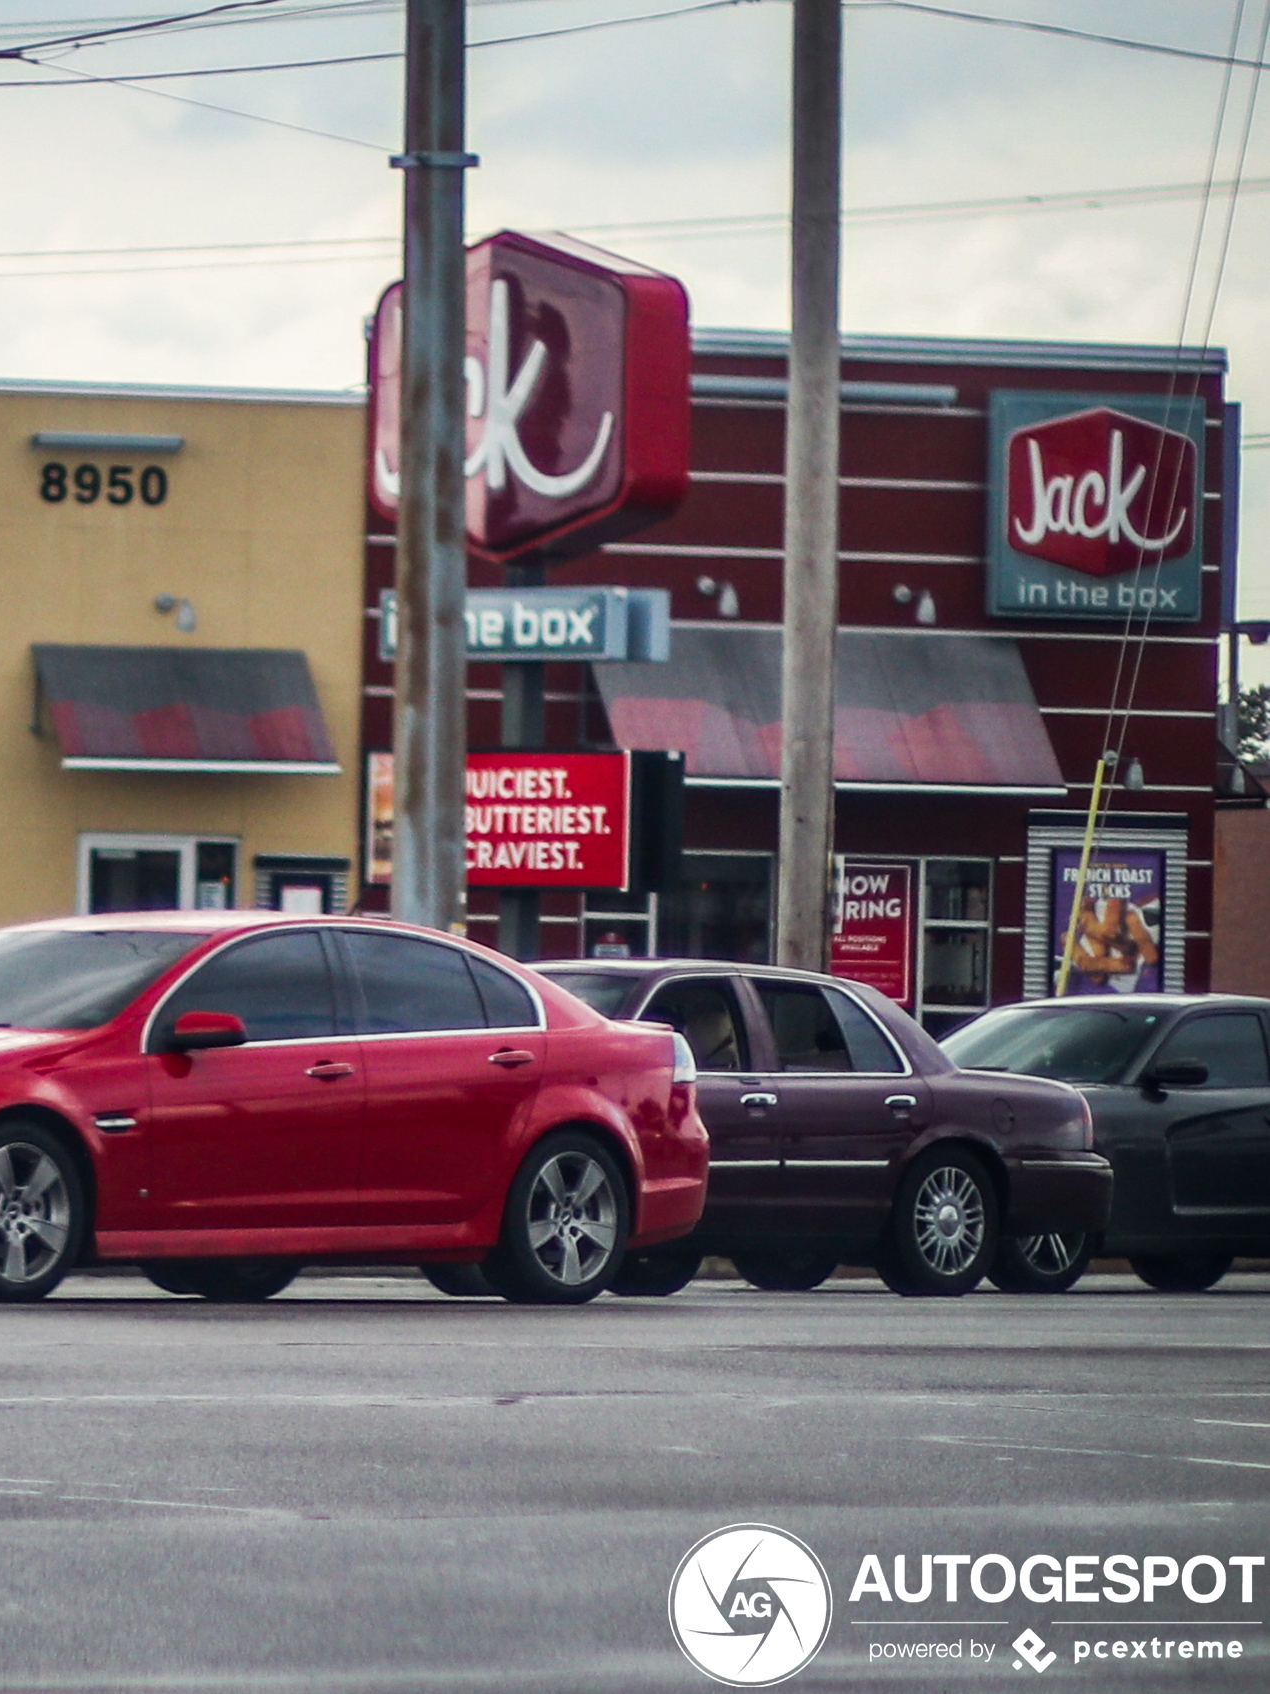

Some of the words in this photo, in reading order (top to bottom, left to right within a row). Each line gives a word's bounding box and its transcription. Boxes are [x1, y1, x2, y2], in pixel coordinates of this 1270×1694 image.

[40, 462, 168, 506] 8950
[1014, 429, 1187, 550] Jack
[1017, 577, 1048, 604] in
[1056, 581, 1109, 606] the
[1118, 582, 1178, 609] box
[513, 602, 596, 647] box
[1063, 867, 1111, 882] FRNCH
[1114, 868, 1153, 884] TOAST
[844, 898, 902, 920] RING
